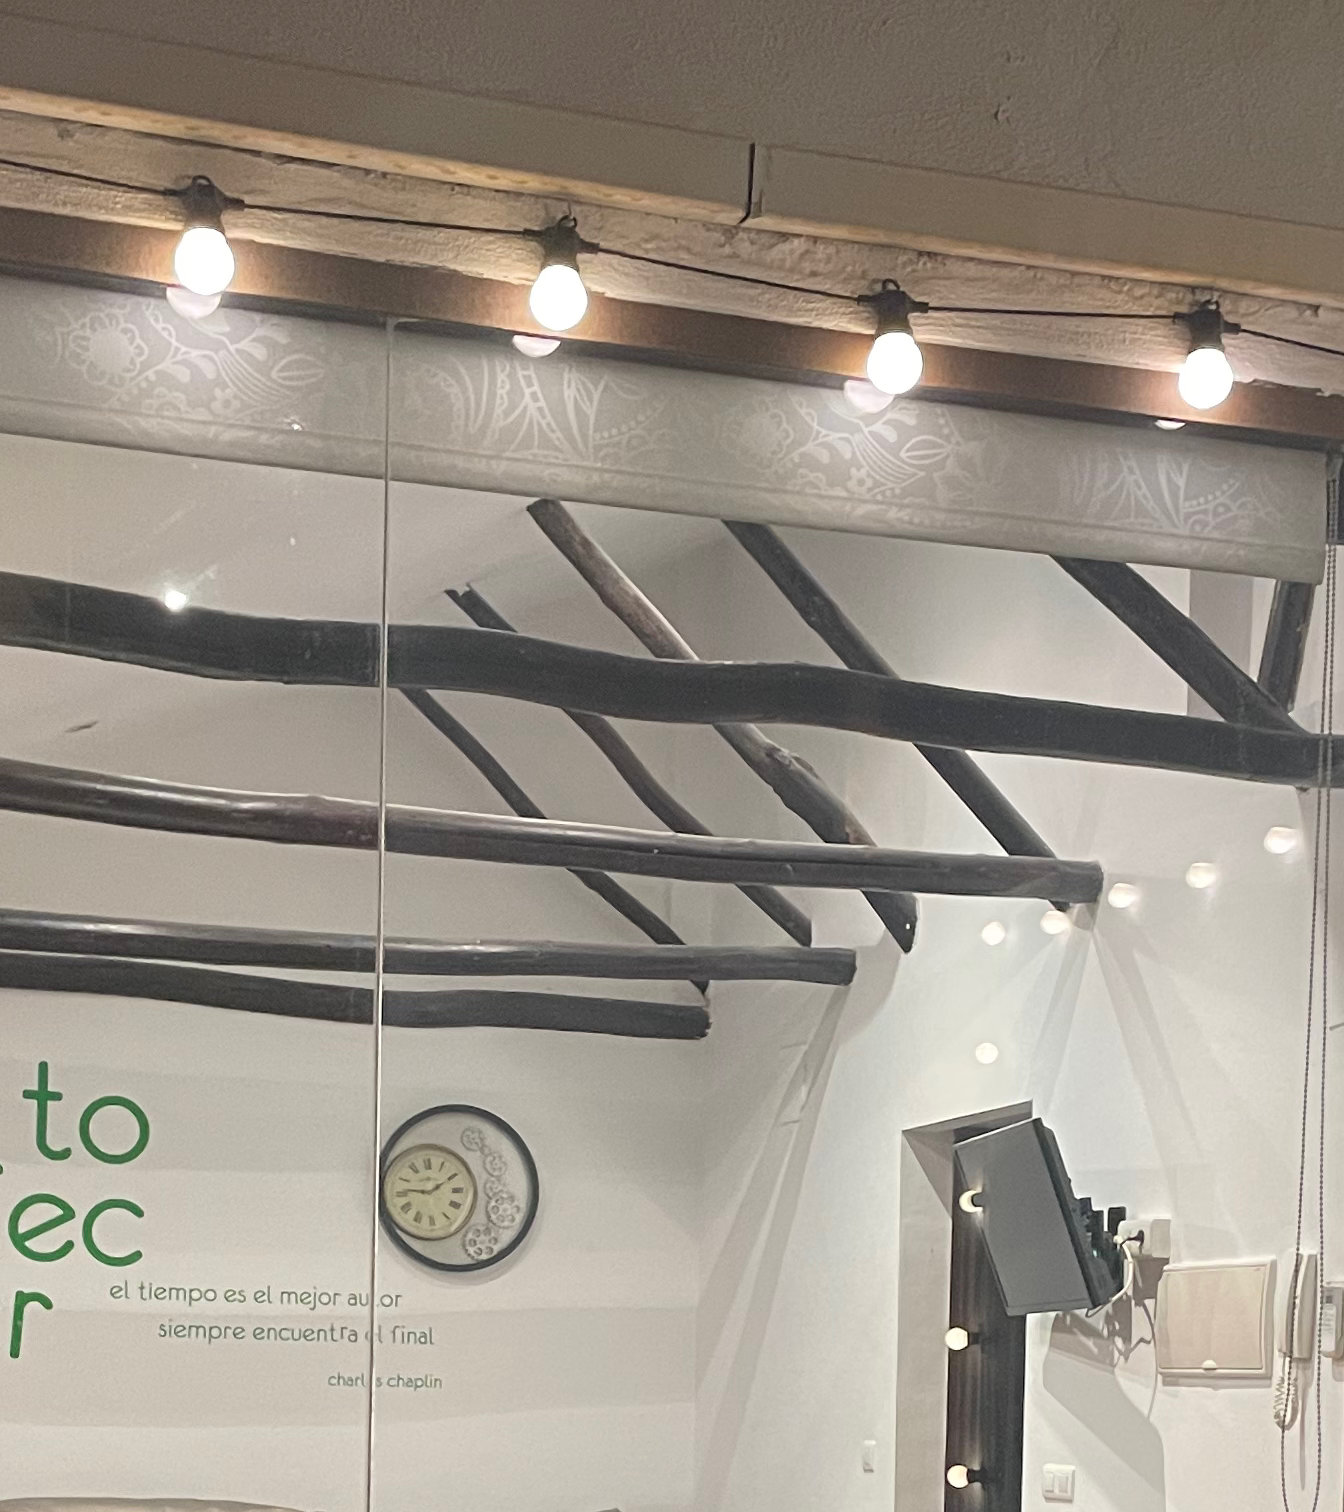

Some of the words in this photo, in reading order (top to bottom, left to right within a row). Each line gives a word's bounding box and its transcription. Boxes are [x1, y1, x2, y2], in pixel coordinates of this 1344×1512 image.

[22, 1060, 150, 1166] to
[109, 1279, 130, 1300] el
[138, 1281, 218, 1306] tiempo
[223, 1288, 247, 1303] es
[253, 1285, 273, 1304] el
[280, 1286, 341, 1311] mejor
[347, 1292, 402, 1308] auor
[158, 1318, 246, 1344] siempre
[252, 1323, 358, 1343] encuentra
[391, 1325, 435, 1345] final
[327, 1372, 383, 1388] charls
[386, 1373, 443, 1391] chaplin
